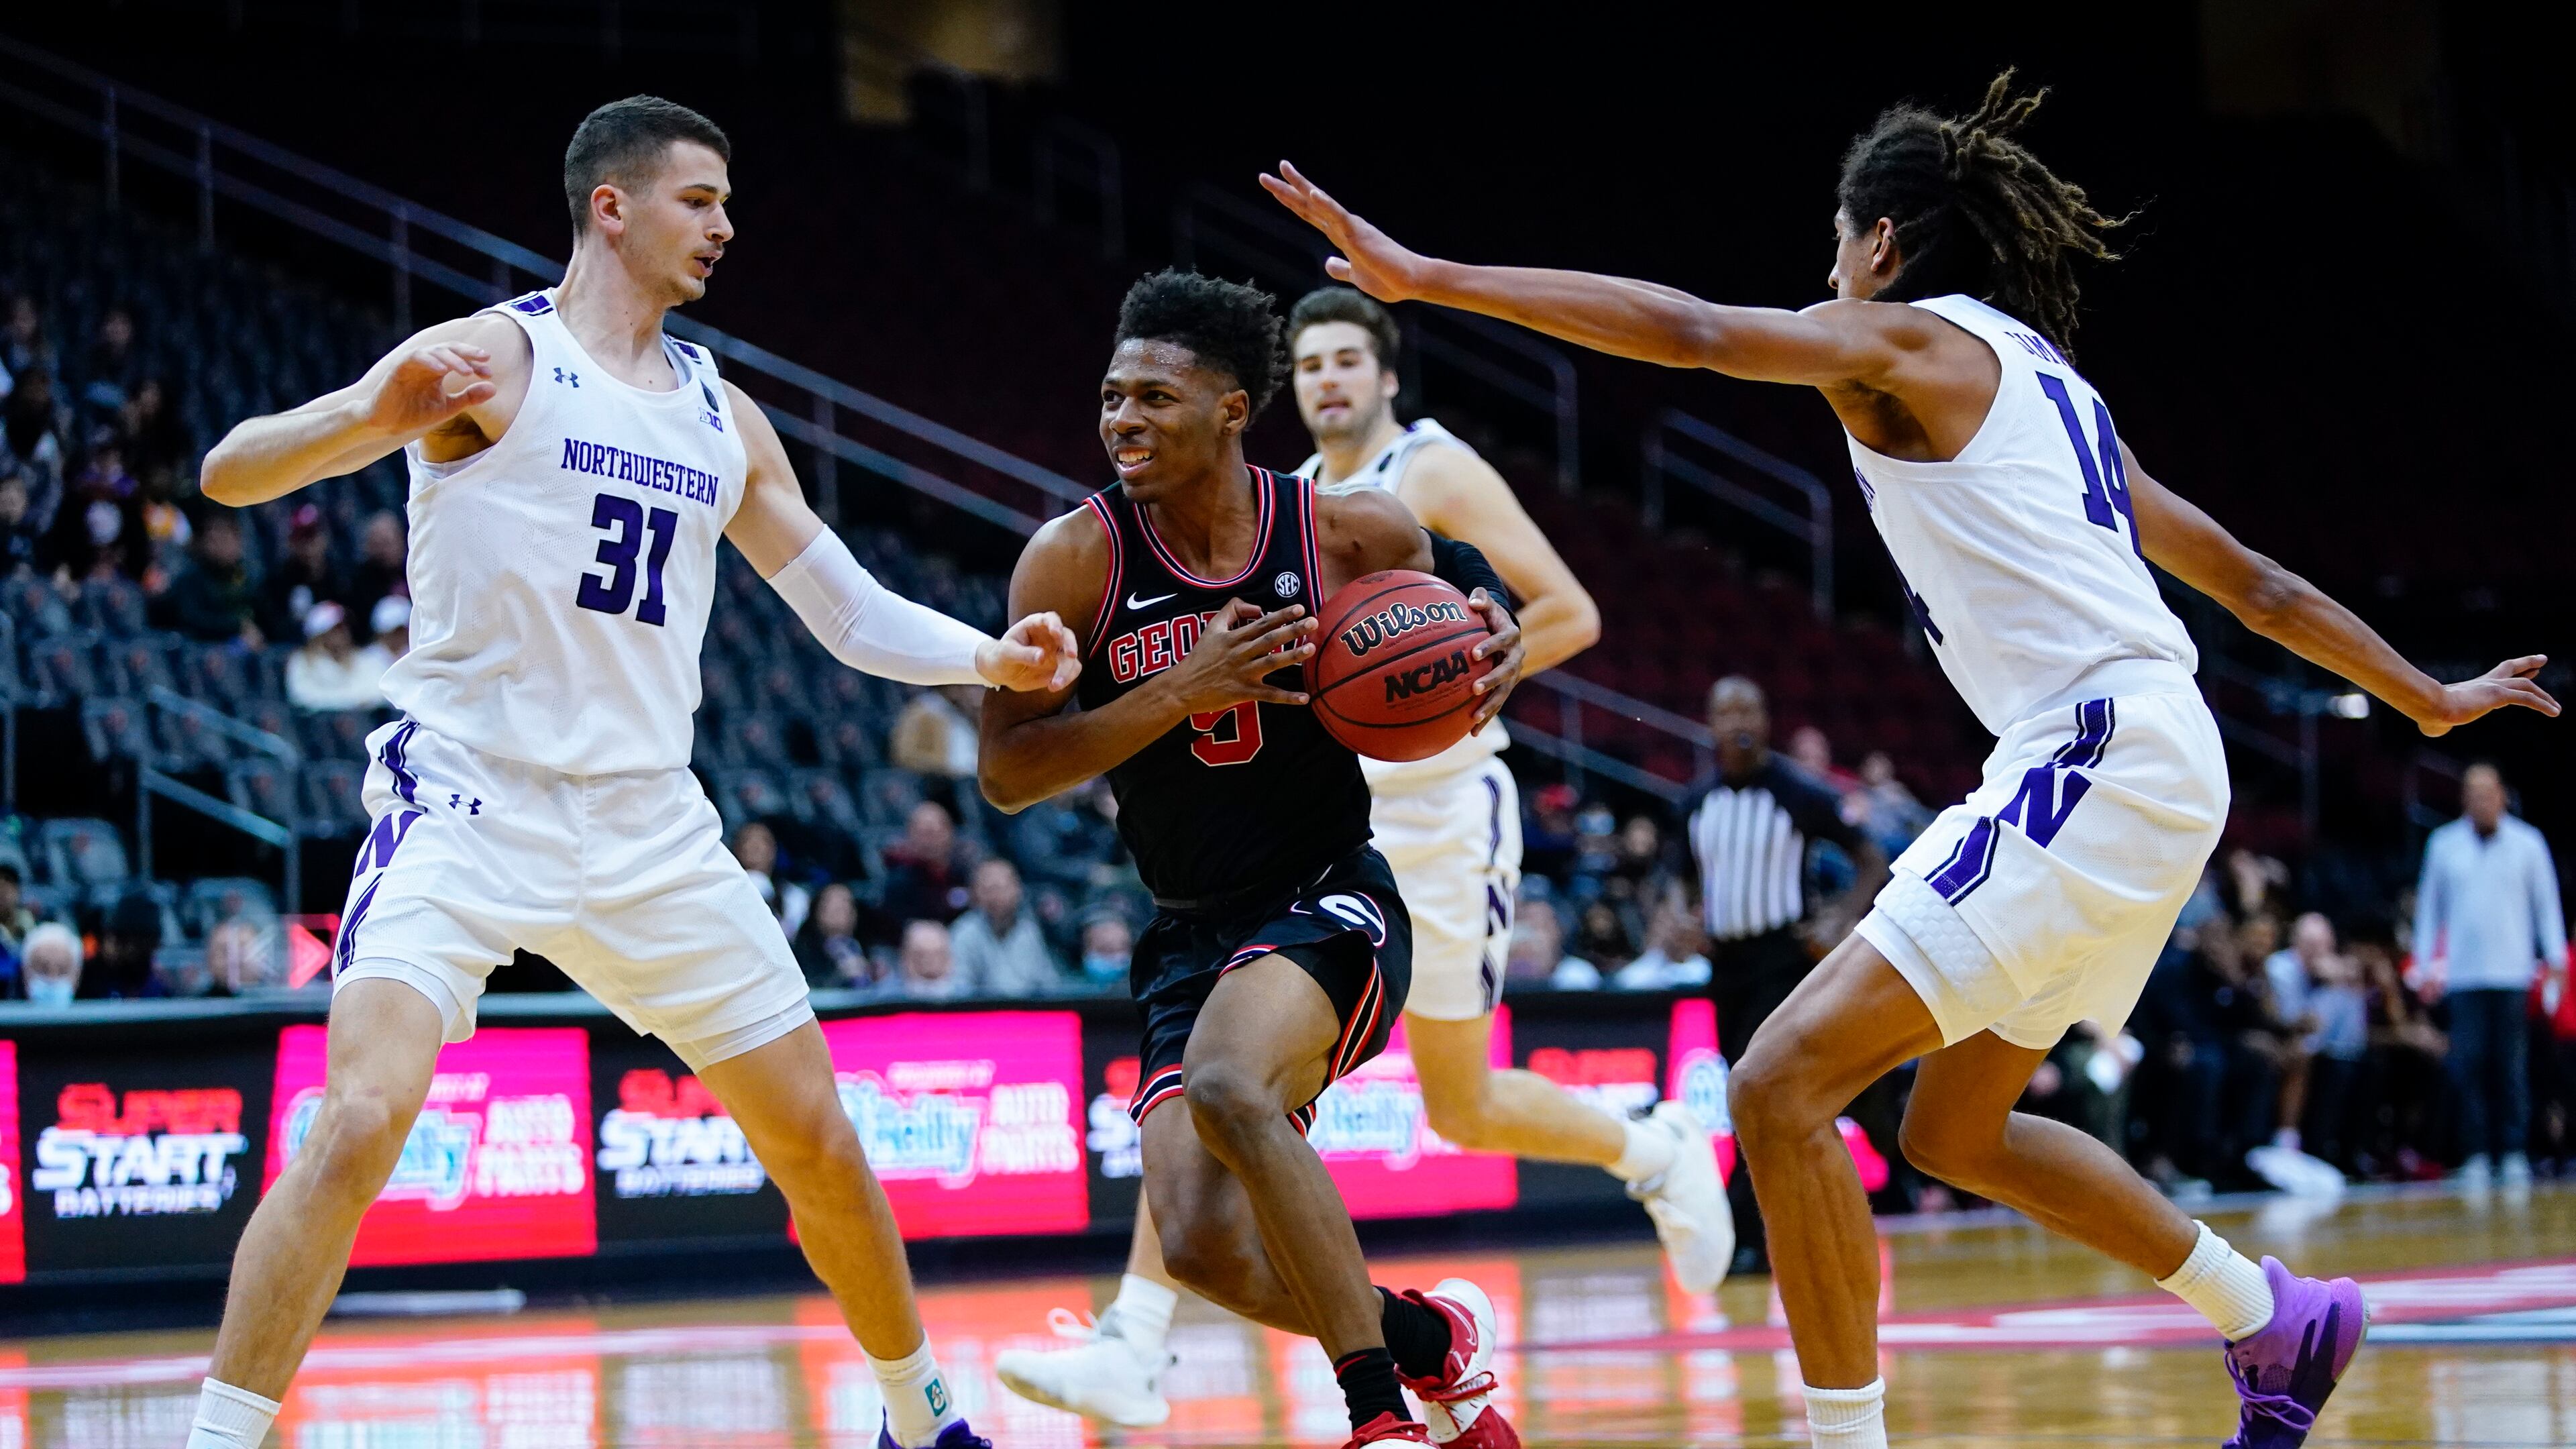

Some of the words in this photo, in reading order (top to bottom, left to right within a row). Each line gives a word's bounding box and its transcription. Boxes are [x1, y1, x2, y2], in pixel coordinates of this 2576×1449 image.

[561, 438, 718, 507] NORTHWESTERN
[2035, 370, 2145, 562] 14
[576, 492, 678, 627] 31
[1277, 574, 1298, 596] SEC
[1340, 602, 1468, 657] Wilson
[1384, 649, 1470, 702] NCAA
[56, 1083, 243, 1134] SUPER
[596, 1108, 755, 1171] STAR
[32, 1126, 250, 1191] START
